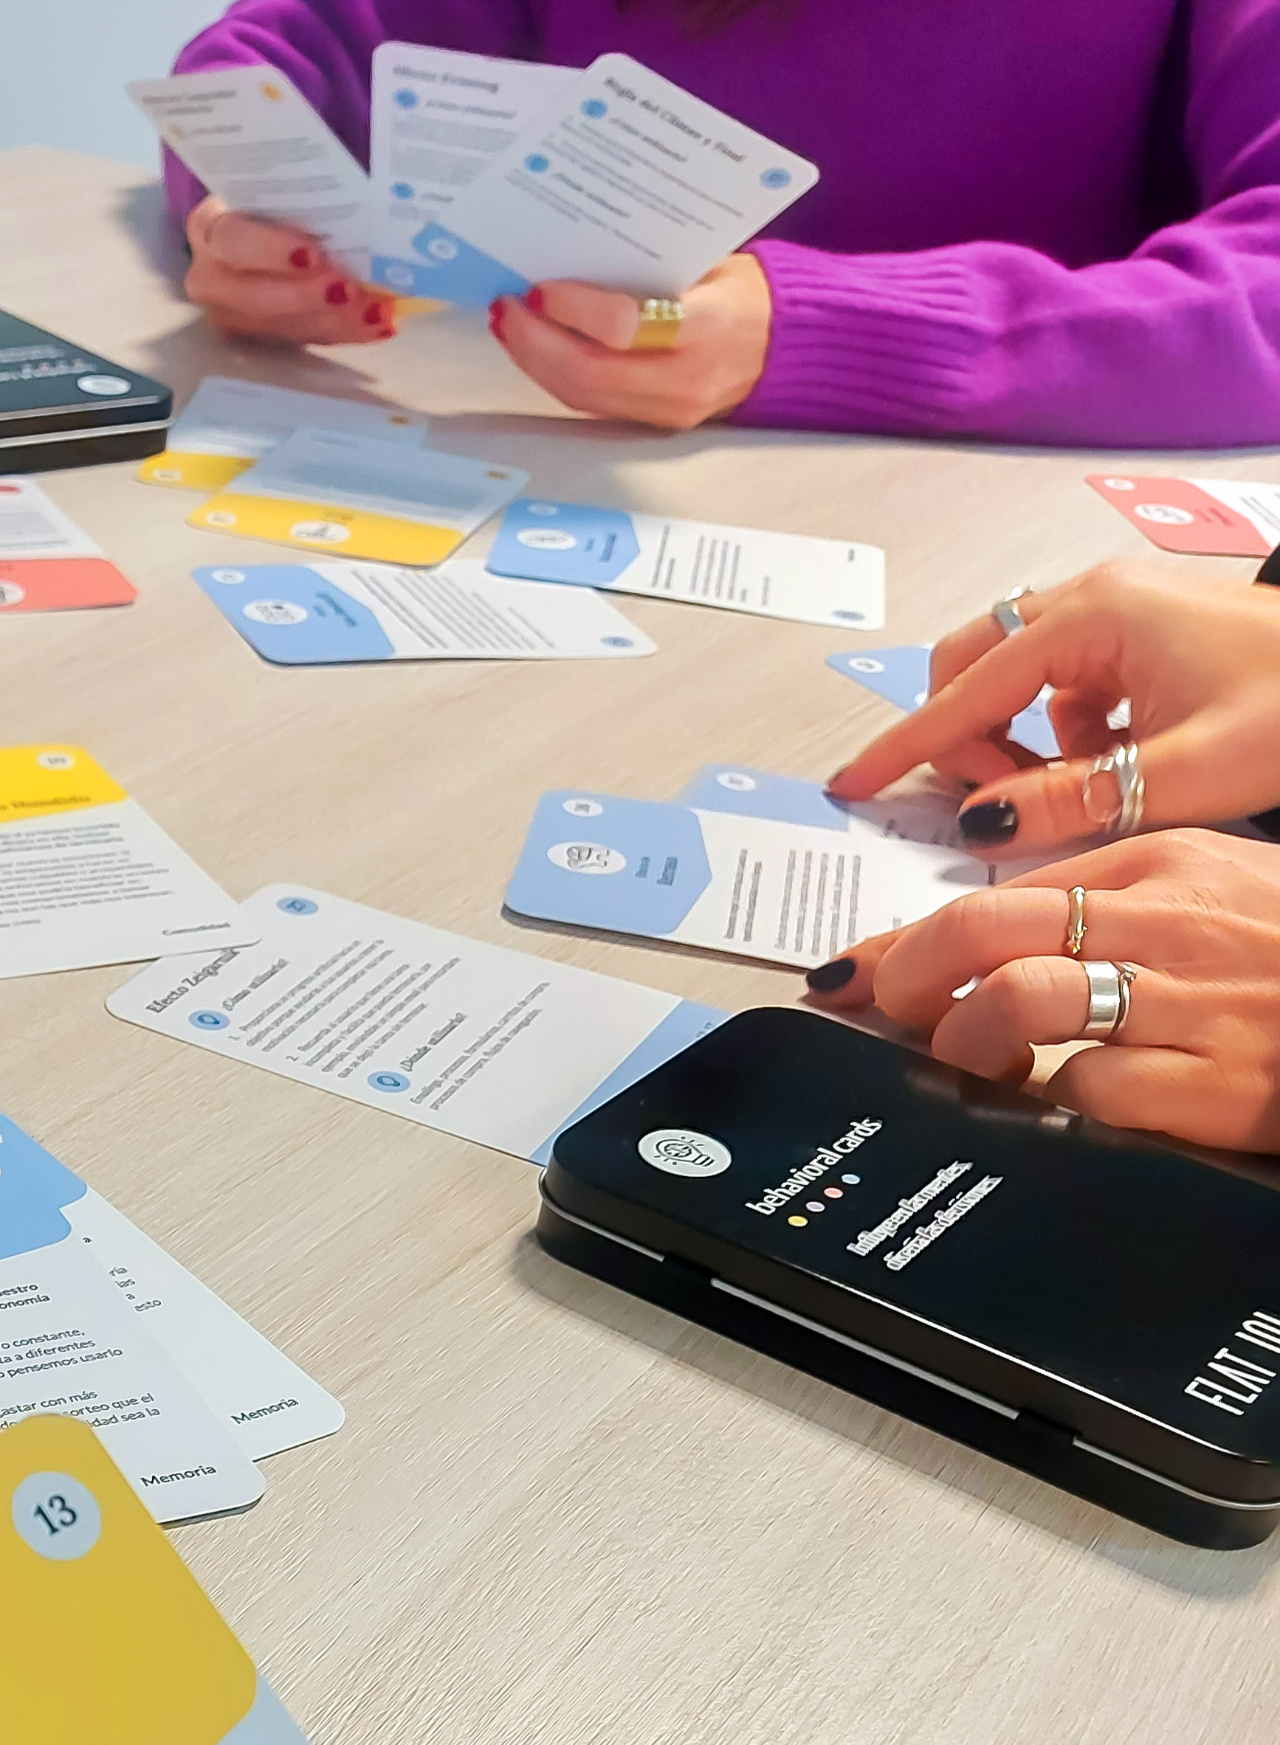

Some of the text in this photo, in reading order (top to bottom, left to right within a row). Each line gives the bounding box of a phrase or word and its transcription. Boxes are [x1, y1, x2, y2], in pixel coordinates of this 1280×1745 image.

[145, 986, 190, 1014] Efecto
[745, 1117, 883, 1215] behavioral cards
[12, 1329, 86, 1348] constante,
[1184, 1347, 1277, 1416] FLAT
[230, 1398, 300, 1425] Memoria
[140, 1465, 217, 1488] Memoria
[33, 1495, 77, 1535] 13
